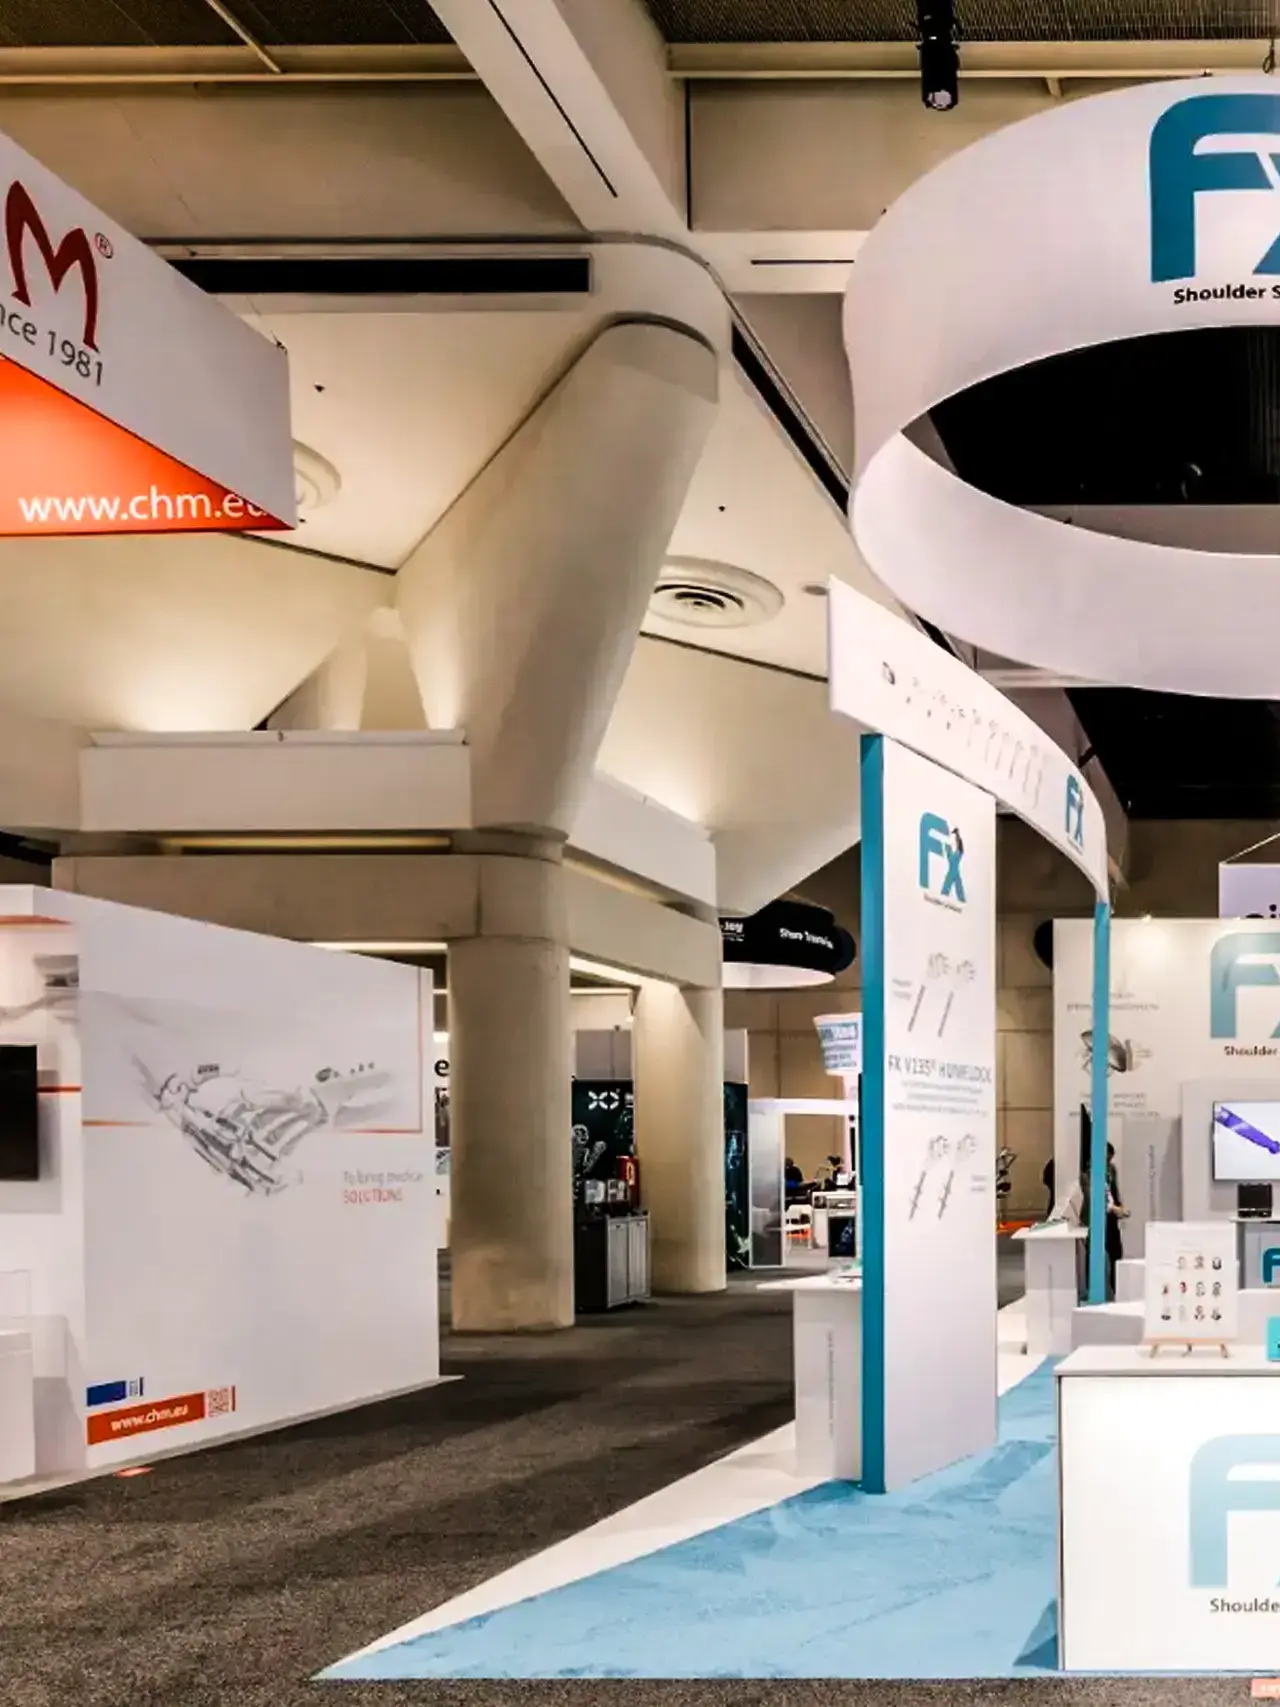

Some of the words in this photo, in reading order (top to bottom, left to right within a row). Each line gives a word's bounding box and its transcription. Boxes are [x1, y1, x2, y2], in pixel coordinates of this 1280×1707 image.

[1173, 284, 1266, 304] Shoulder
[47, 331, 104, 387] 1981
[1223, 1045, 1277, 1056] Shoulder
[110, 1403, 189, 1432] www.chm.eu
